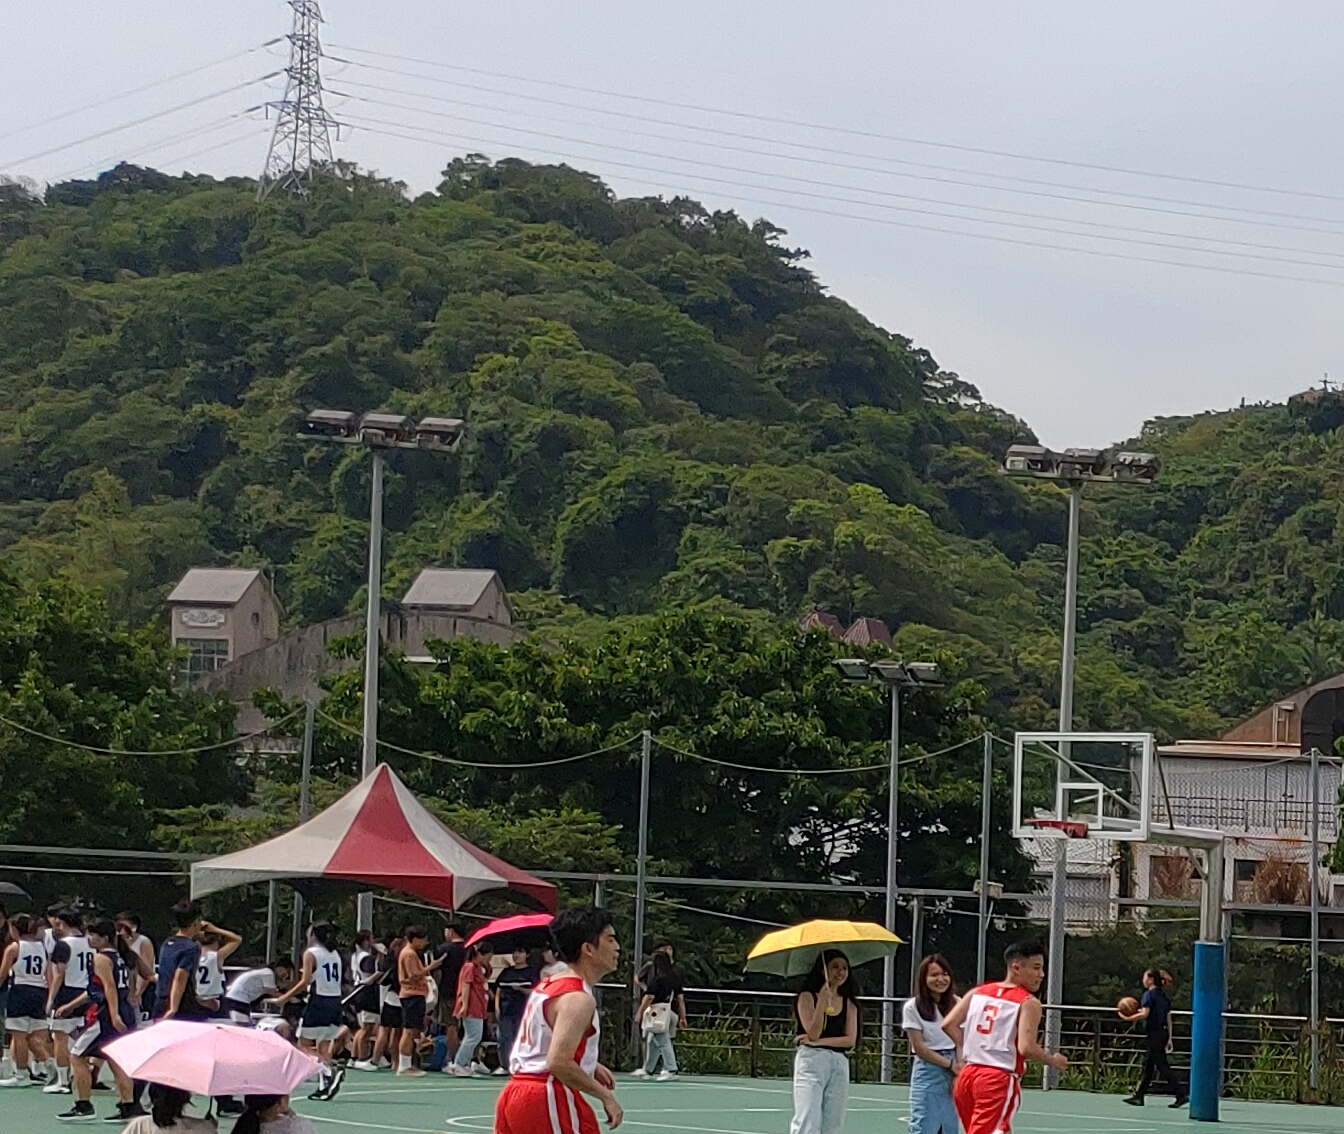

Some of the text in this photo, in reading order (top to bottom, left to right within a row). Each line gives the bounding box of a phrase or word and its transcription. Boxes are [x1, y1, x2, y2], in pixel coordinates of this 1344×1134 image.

[22, 954, 43, 975] 13
[322, 962, 340, 982] 14
[976, 1004, 1000, 1035] 3
